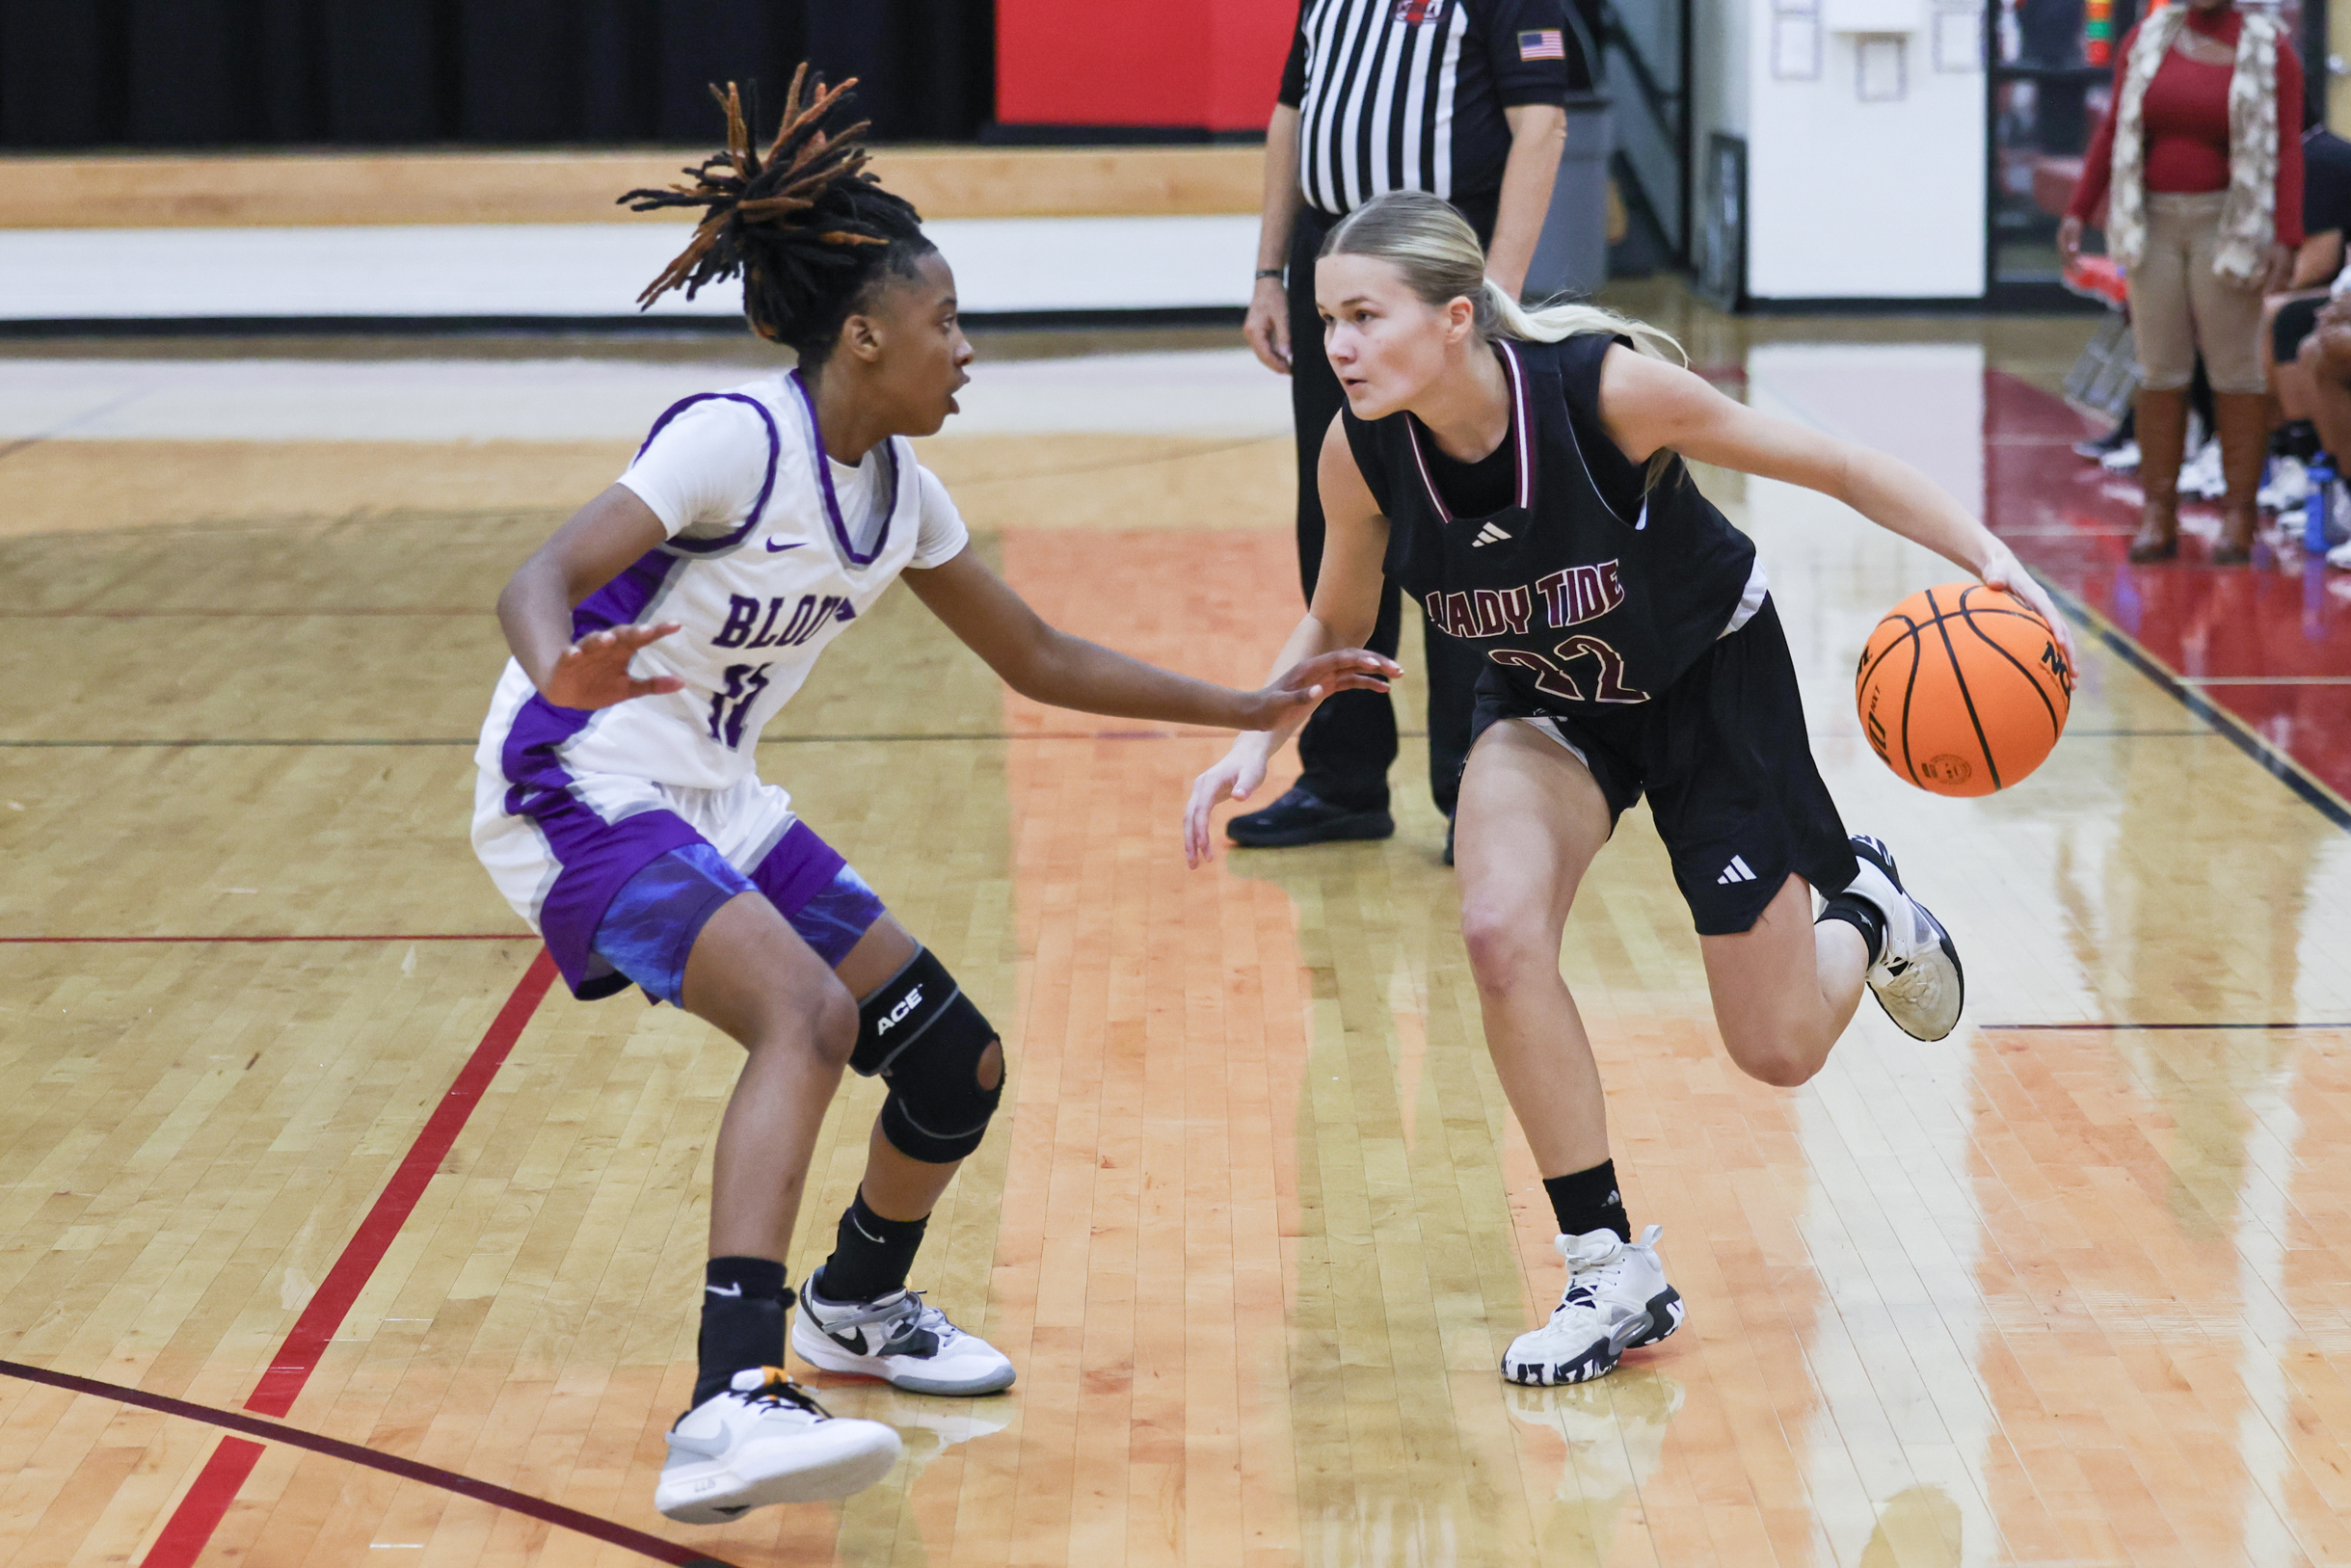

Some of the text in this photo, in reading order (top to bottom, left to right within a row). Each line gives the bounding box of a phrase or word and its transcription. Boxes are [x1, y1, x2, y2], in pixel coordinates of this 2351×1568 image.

[1426, 558, 1625, 639] LADY TIDE
[1487, 634, 1651, 704] 22
[877, 986, 923, 1037] ACE
